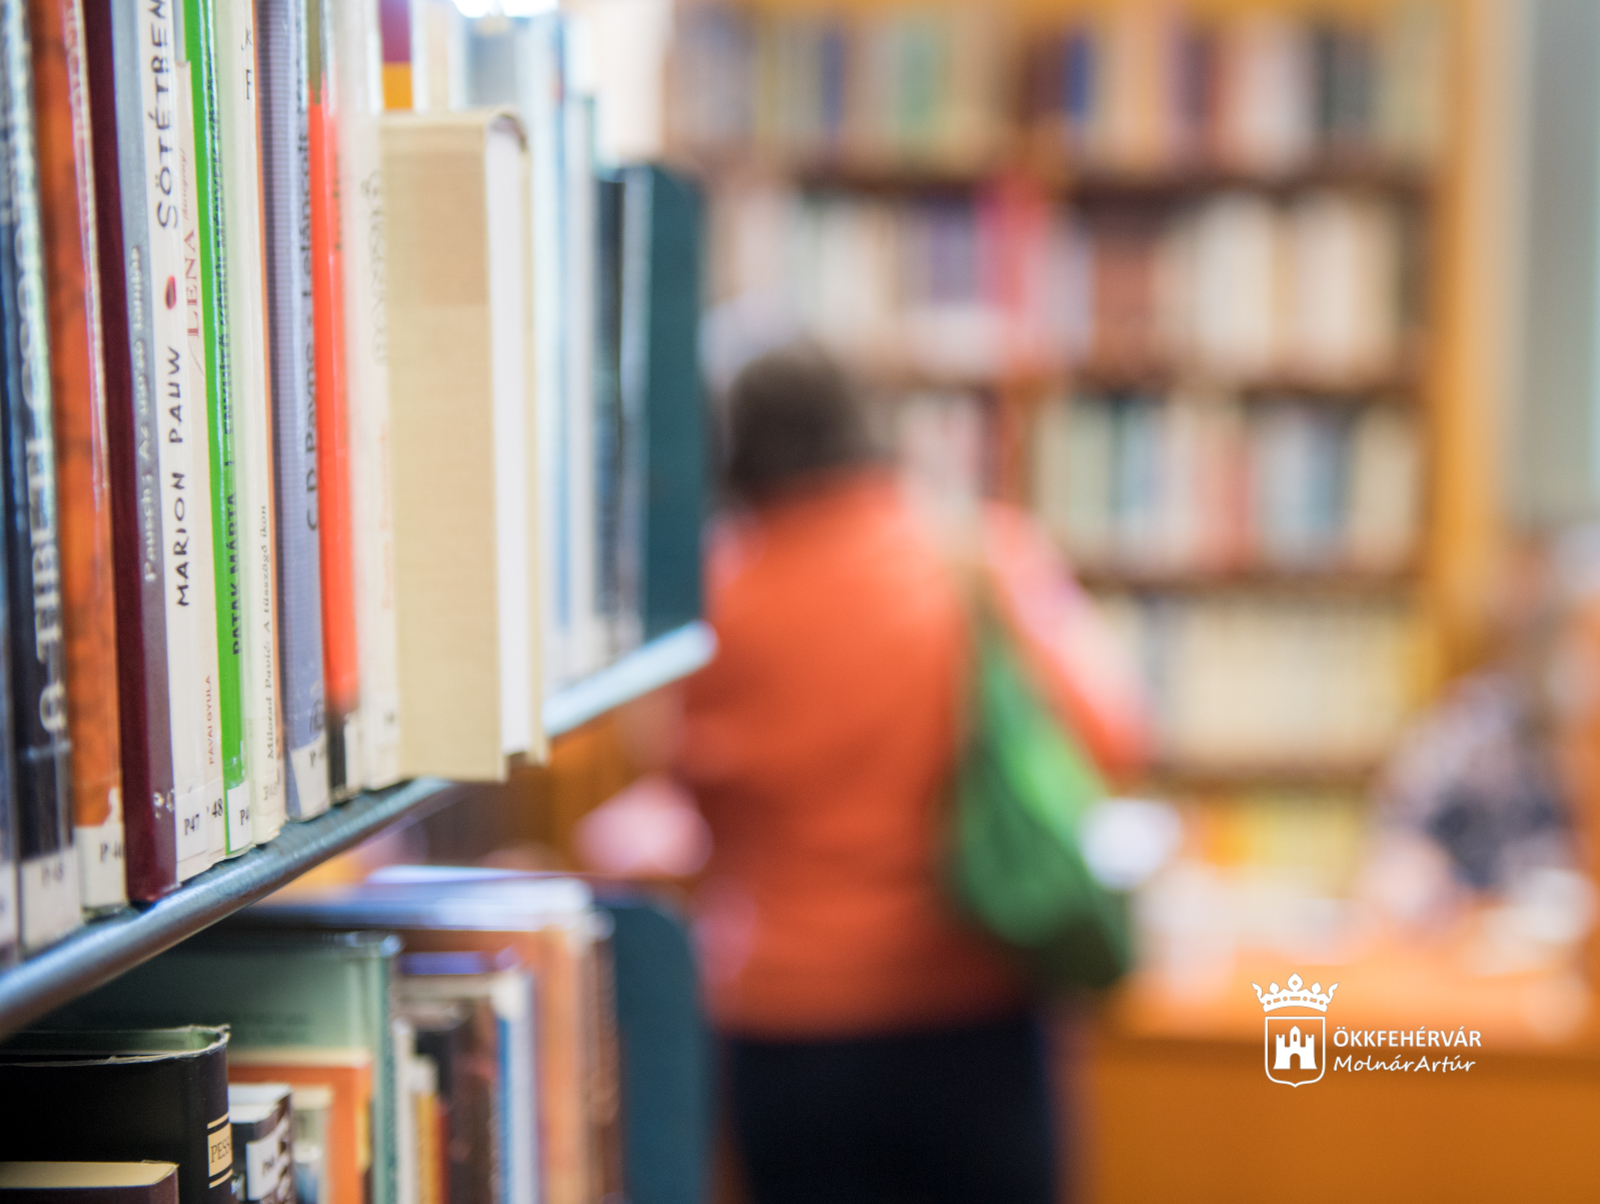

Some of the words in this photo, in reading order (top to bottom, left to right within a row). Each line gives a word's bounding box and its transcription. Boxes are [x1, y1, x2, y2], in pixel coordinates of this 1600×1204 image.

[183, 230, 199, 336] LENA
[166, 345, 184, 443] PAUW
[171, 471, 189, 606] MARION
[226, 492, 240, 574] MÁRTA
[258, 504, 268, 538] ikon
[230, 582, 243, 655] PATAK
[261, 620, 270, 632] A
[203, 674, 214, 721] GYULA
[265, 697, 275, 759] Milorad
[183, 813, 200, 836] P47
